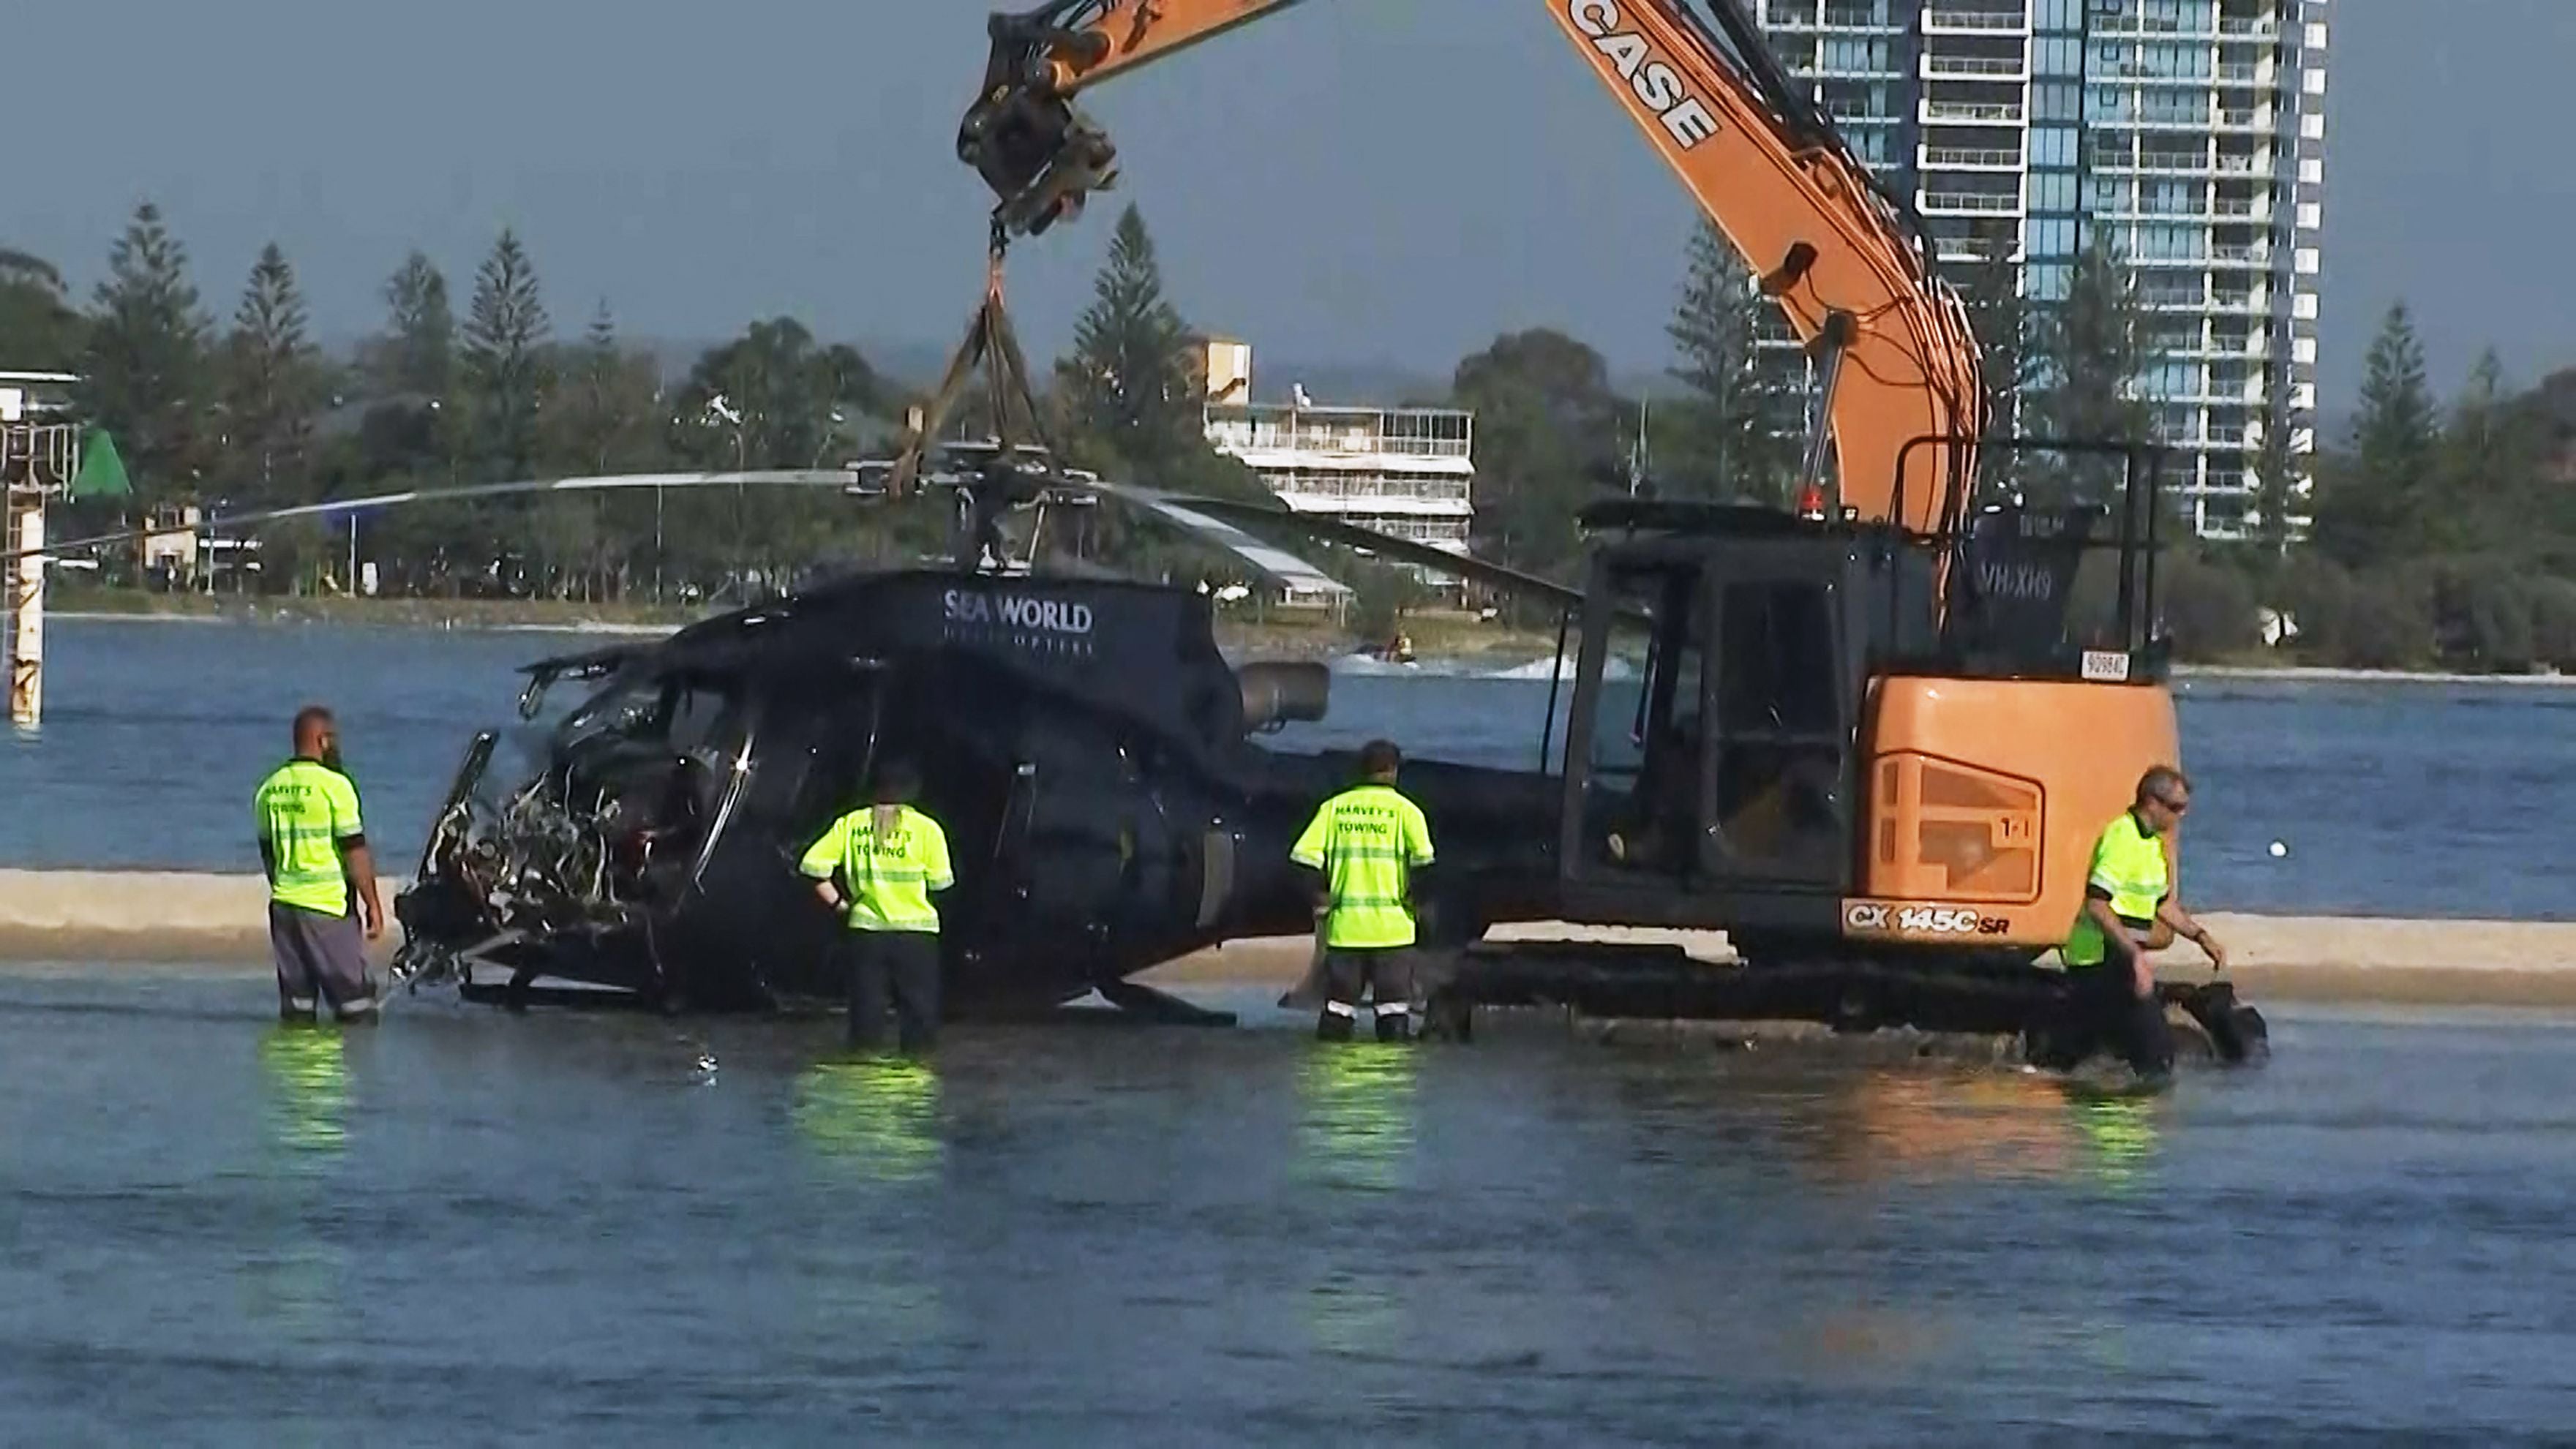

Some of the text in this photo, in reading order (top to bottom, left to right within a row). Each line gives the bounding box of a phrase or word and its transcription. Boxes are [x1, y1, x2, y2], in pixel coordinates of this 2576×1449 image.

[1569, 0, 1721, 151] CASE
[944, 590, 1093, 633] SEA WORLD
[1336, 805, 1394, 818] HARVEY'S
[1338, 823, 1387, 835] TOWING
[1848, 906, 2010, 934] CX 145C SR
